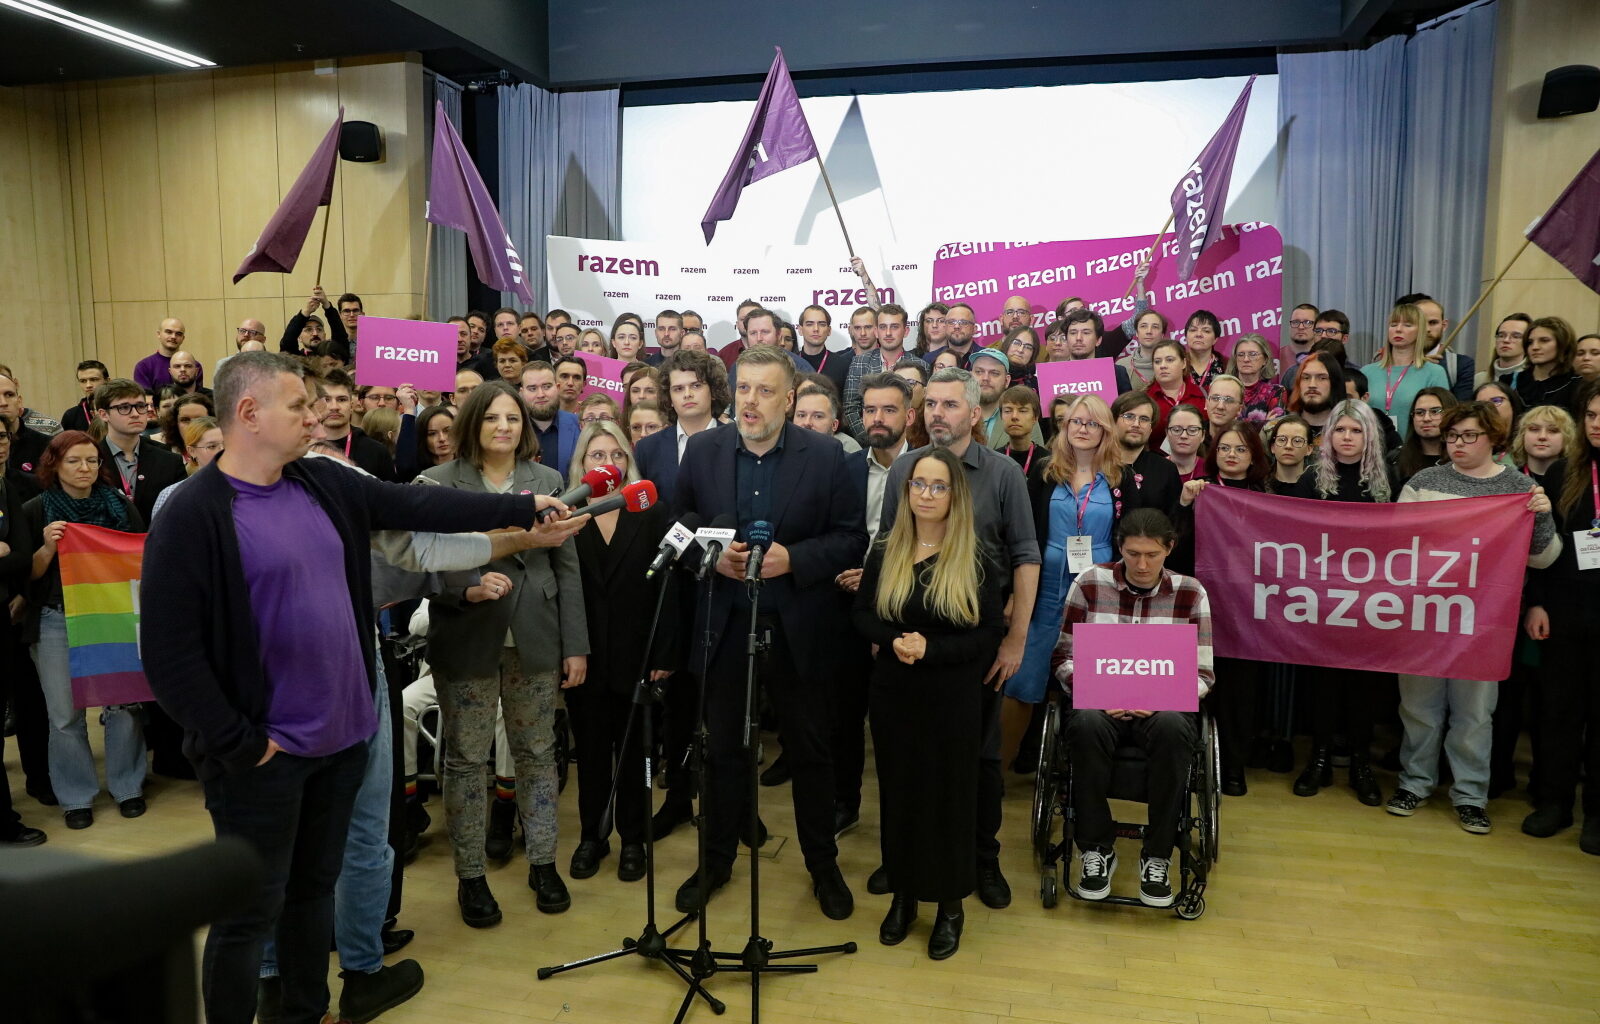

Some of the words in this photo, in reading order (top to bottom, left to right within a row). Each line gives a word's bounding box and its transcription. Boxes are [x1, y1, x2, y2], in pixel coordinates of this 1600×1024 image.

[938, 241, 995, 260] azem
[577, 253, 660, 277] razem
[680, 266, 707, 275] razem
[733, 267, 760, 275] razem
[786, 267, 813, 275] razem
[891, 263, 918, 271] razem
[935, 278, 999, 302] razem
[1007, 264, 1077, 291] razem
[1086, 246, 1153, 277] razem
[603, 289, 630, 299] razem
[655, 291, 682, 301] razem
[707, 293, 734, 303] razem
[1165, 270, 1236, 303] razem
[812, 287, 895, 306] razem
[577, 319, 604, 327] razem
[375, 344, 439, 364] razem
[1053, 380, 1103, 395] razem
[673, 532, 685, 543] 24
[1253, 532, 1480, 589] młodzi
[1252, 581, 1476, 636] razem
[1095, 657, 1175, 677] razem
